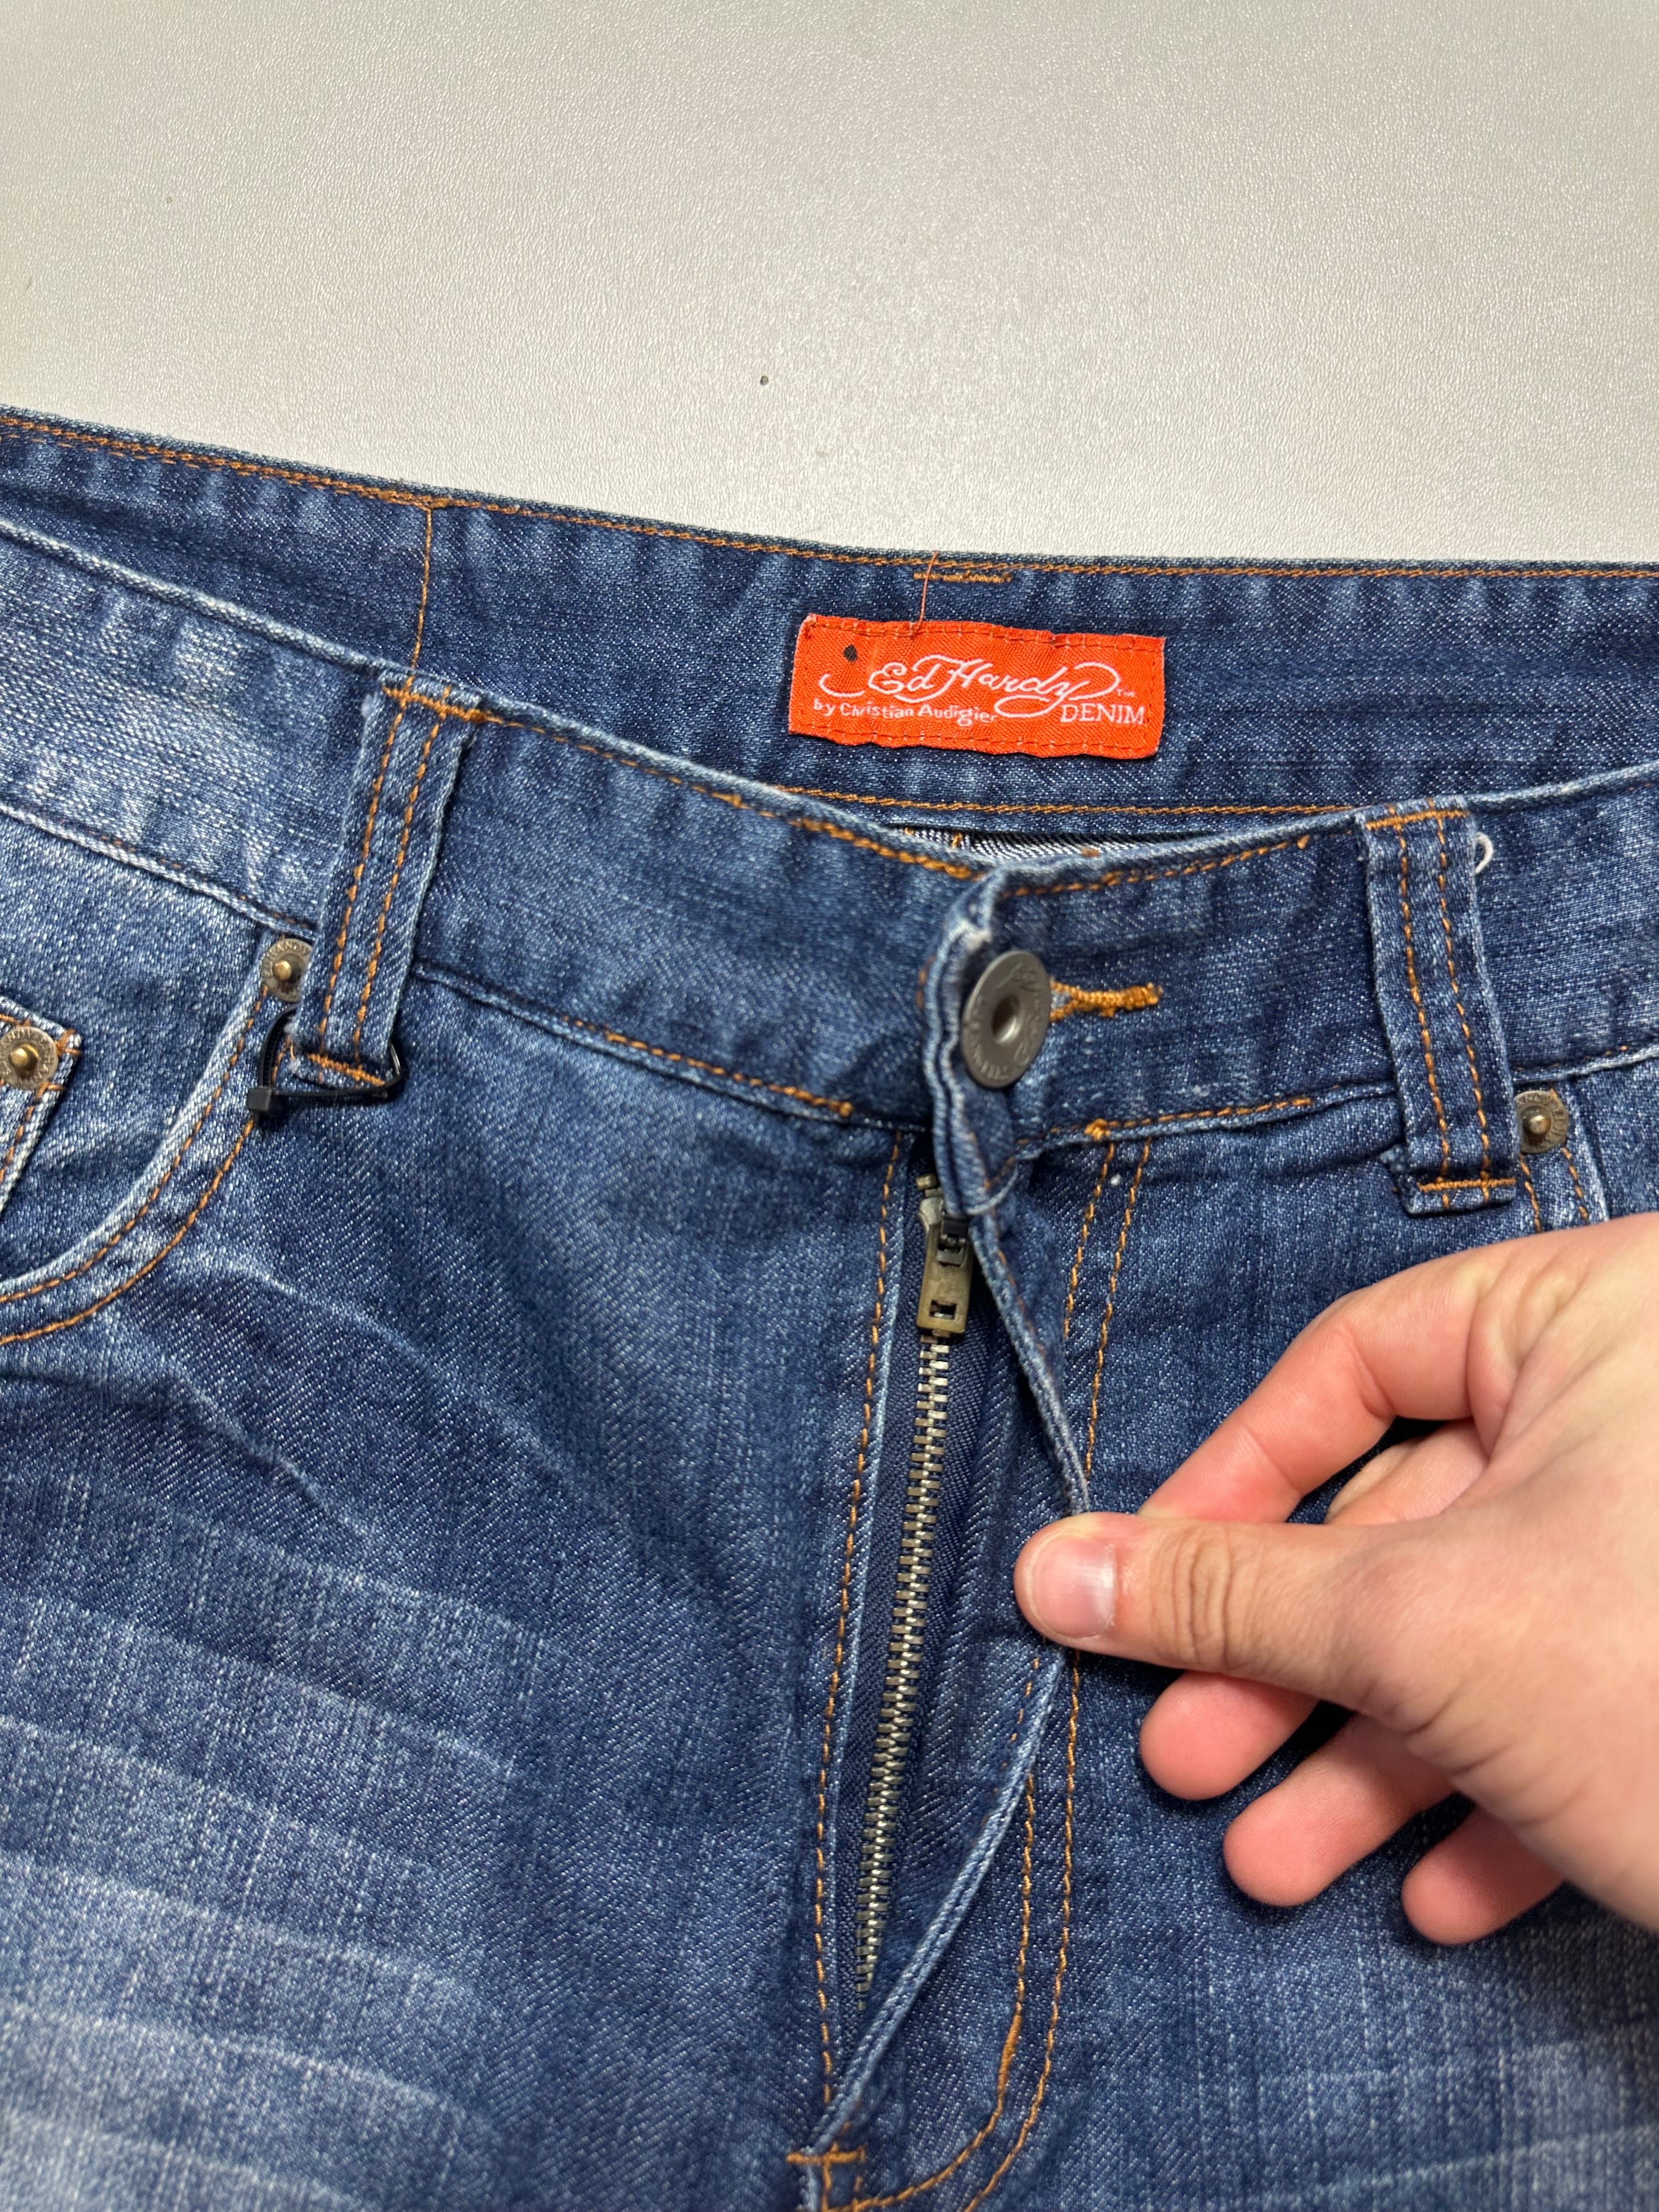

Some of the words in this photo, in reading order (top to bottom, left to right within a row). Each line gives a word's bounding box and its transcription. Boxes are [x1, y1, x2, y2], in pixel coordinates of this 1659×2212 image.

[867, 662, 941, 695] Ed
[894, 654, 1121, 718] Hardy
[813, 698, 836, 716] by
[839, 701, 914, 719] Christian
[917, 704, 997, 726] Audigier
[1060, 703, 1145, 725] DENIM
